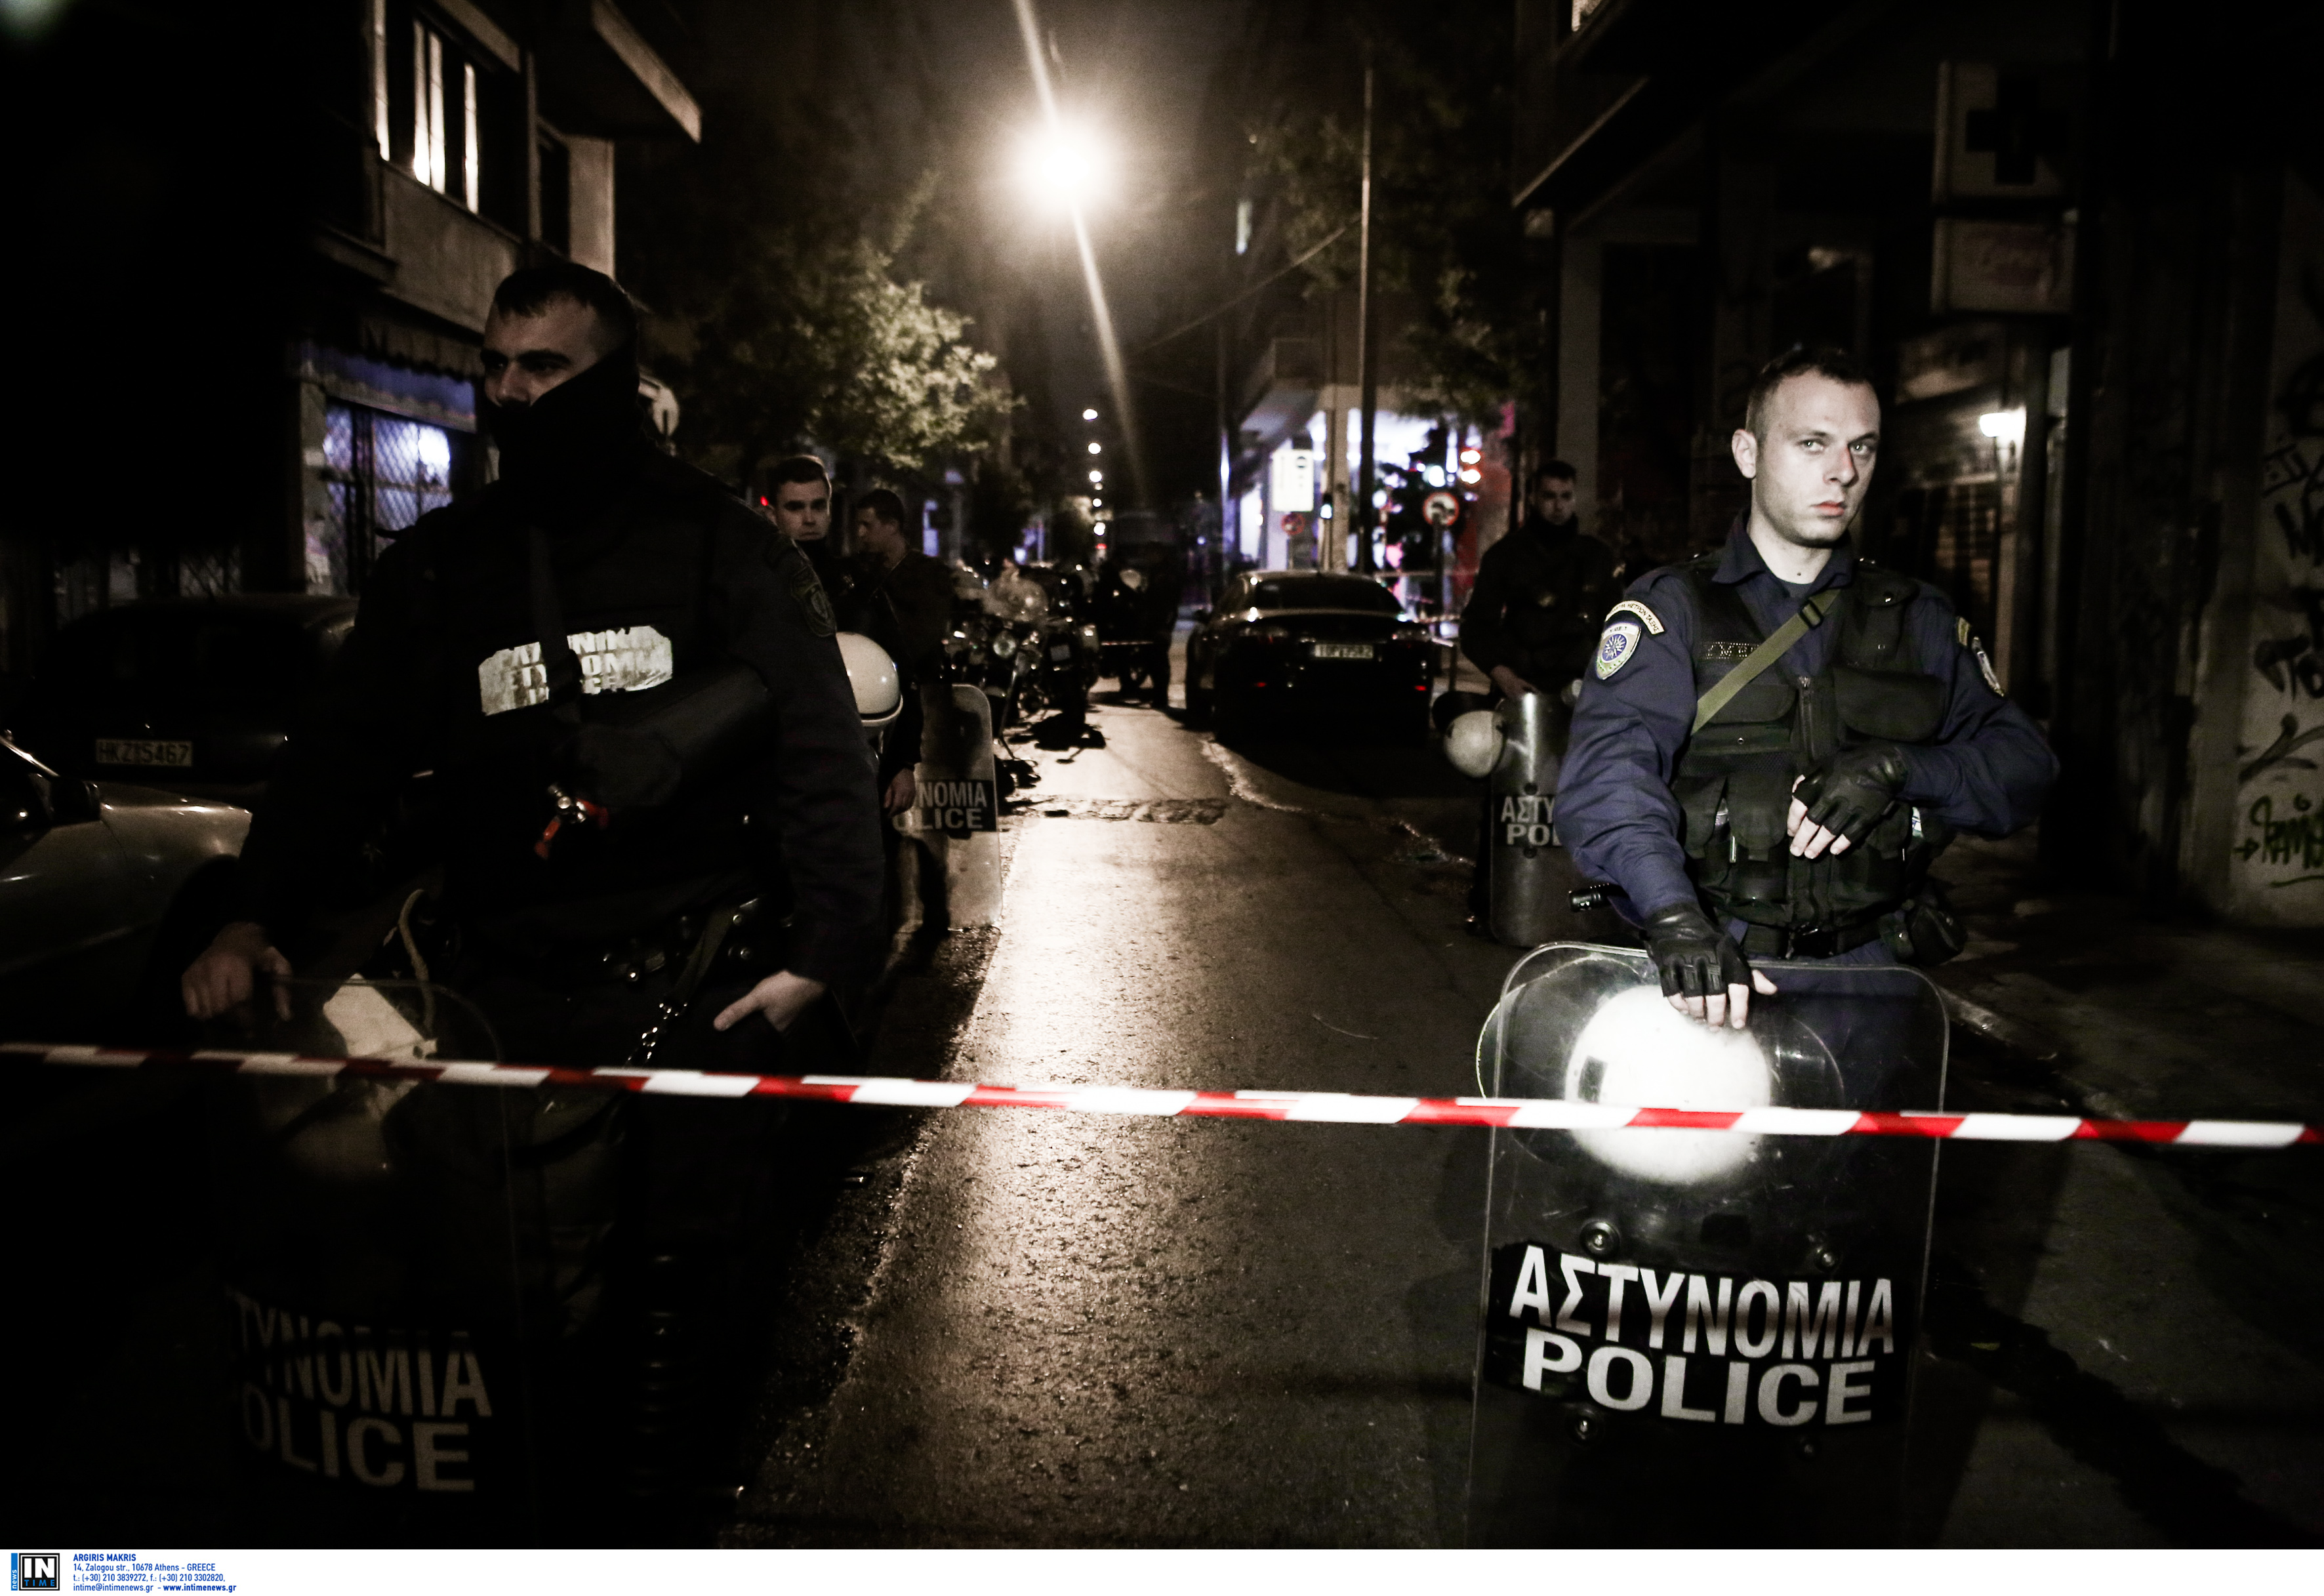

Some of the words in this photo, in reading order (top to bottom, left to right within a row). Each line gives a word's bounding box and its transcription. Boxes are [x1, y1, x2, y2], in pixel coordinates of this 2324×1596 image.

[1508, 1244, 1895, 1360] ΑΣΤΥΝΟΜΙΑ
[1522, 1327, 1876, 1427] POLICE
[241, 1380, 477, 1494] OLICE
